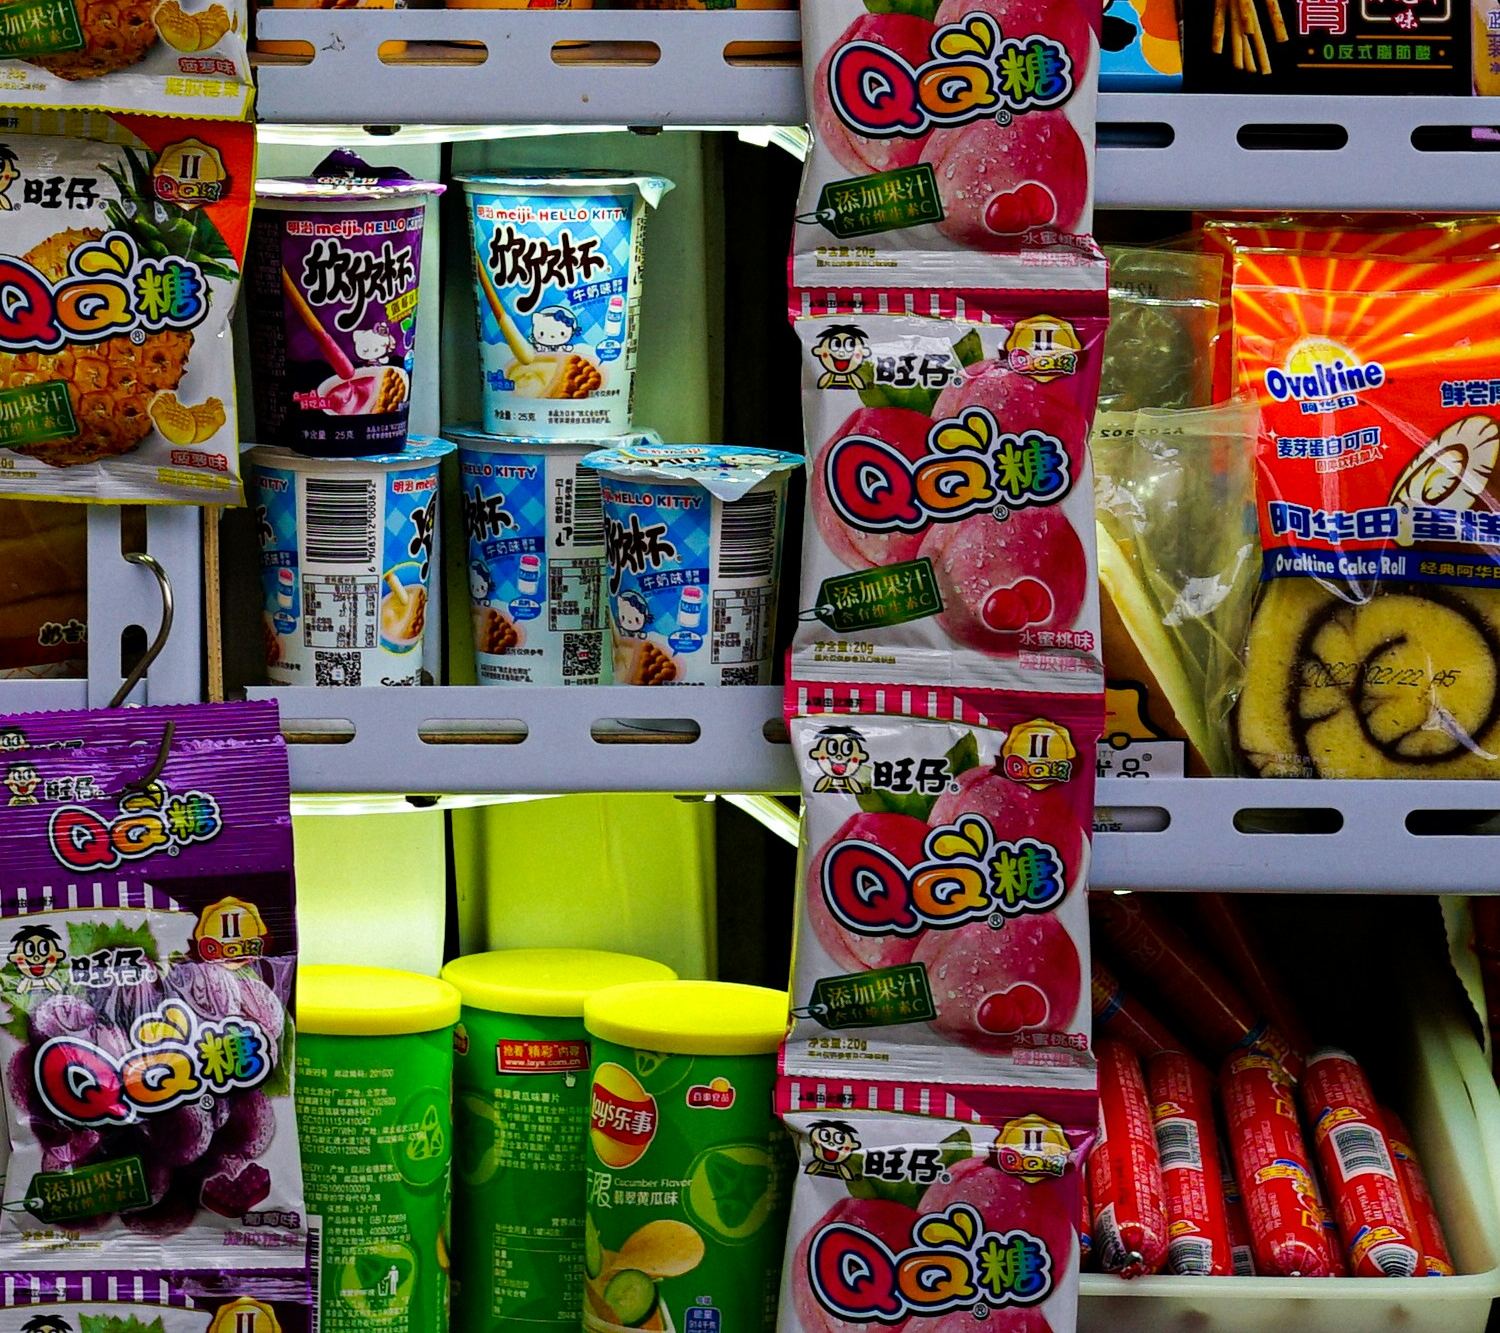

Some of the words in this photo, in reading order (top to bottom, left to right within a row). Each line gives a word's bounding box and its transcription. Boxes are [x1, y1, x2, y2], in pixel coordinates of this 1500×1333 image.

[1322, 41, 1432, 63] 0反式脂肪酸
[572, 285, 612, 304] 牛奶味
[1266, 362, 1385, 401] Ovaltine
[1270, 502, 1398, 542] 阿华田
[1277, 551, 1334, 576] Ovaltine
[1338, 555, 1373, 575] Cake
[1376, 557, 1405, 576] Roll
[614, 1177, 656, 1189] Cucumber
[613, 1191, 678, 1209] 翡翠黄瓜味
[242, 1212, 301, 1228] 葡萄味
